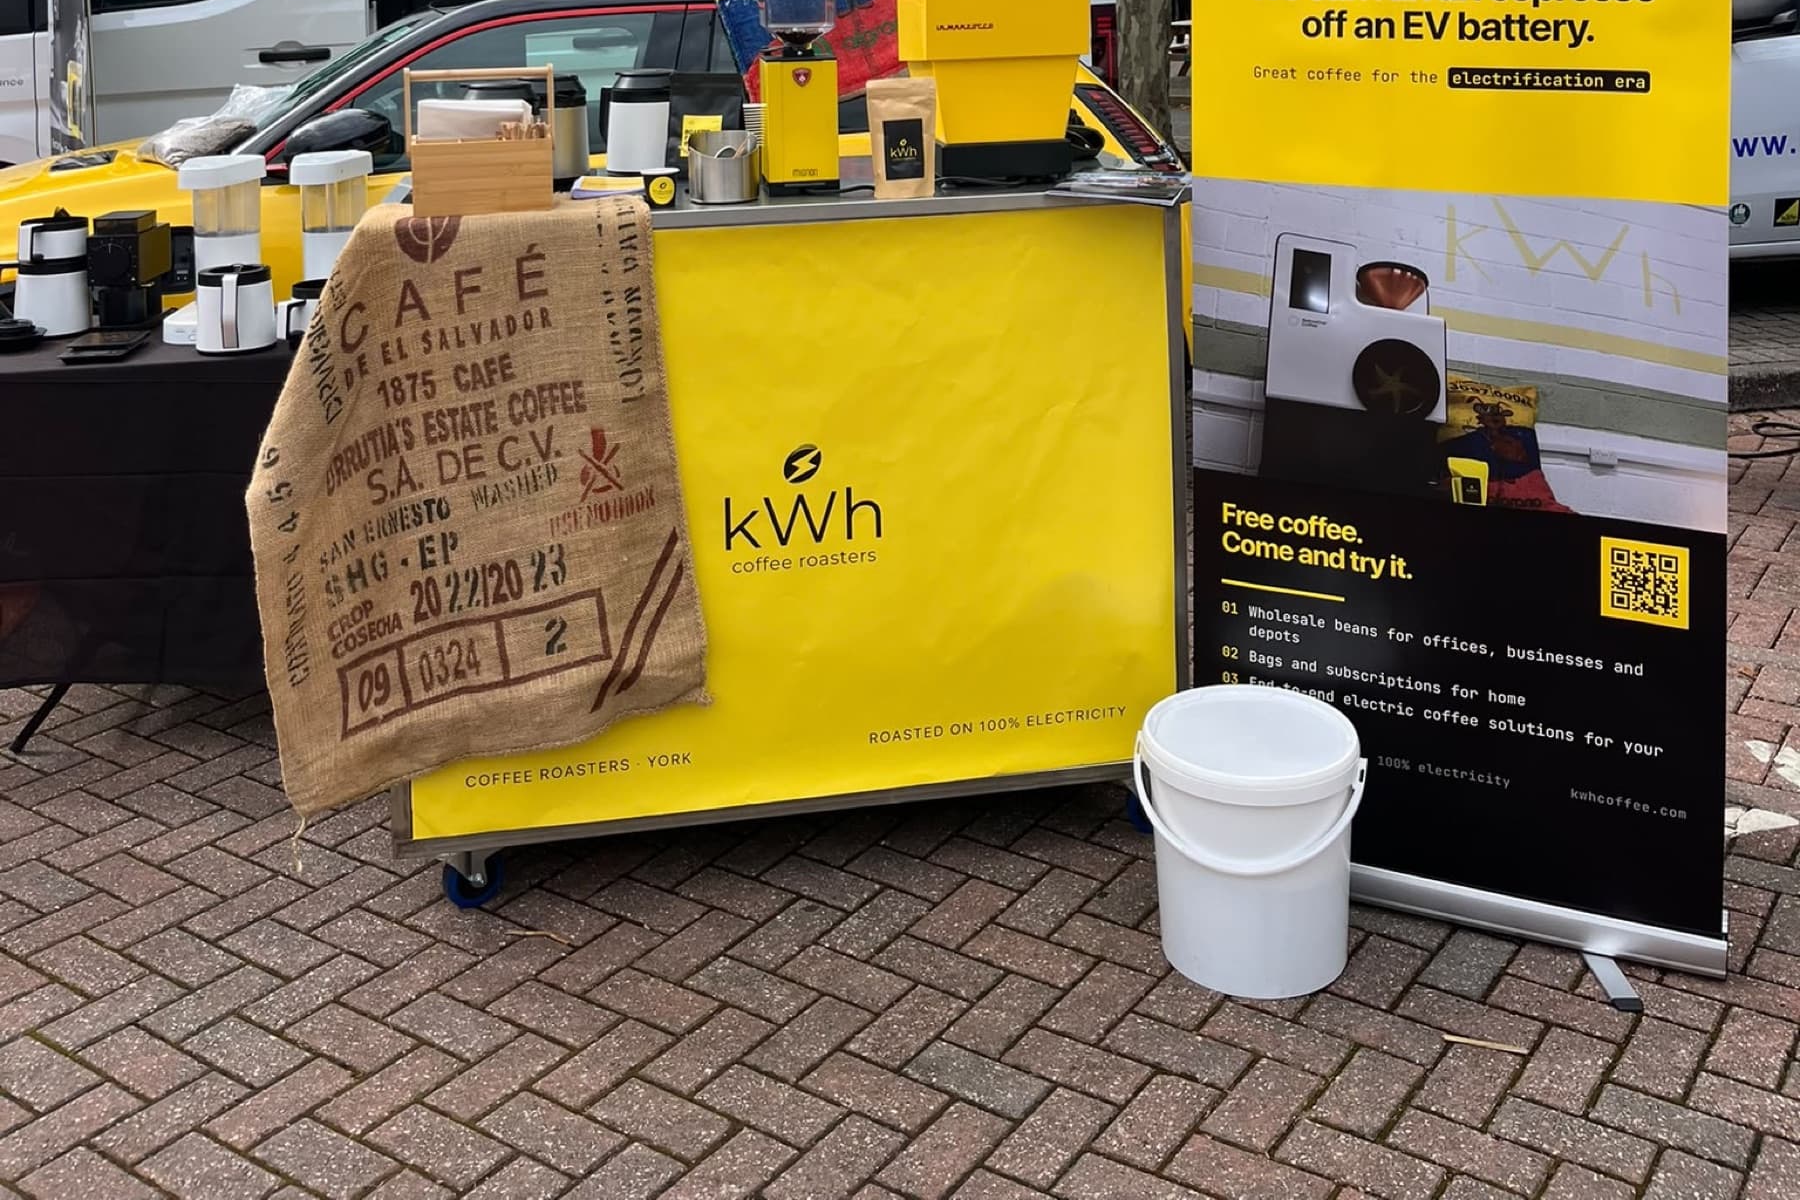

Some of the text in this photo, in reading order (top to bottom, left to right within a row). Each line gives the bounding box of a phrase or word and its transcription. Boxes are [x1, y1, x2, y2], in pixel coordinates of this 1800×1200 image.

[1302, 10, 1595, 48] off an EV battery.
[1253, 65, 1646, 89] Great coffee for the electrification era
[890, 145, 917, 158] kWh
[1444, 198, 1681, 315] kWh
[340, 243, 549, 354] CAFÉ
[345, 306, 552, 391] DE EL SALVADOR
[377, 353, 517, 409] 1875 CAFE
[423, 400, 499, 446] ESTATE
[508, 380, 588, 425] COFFEE
[366, 424, 562, 506] S.A. DE C.V.
[363, 497, 451, 544] ERNESTO
[724, 486, 882, 551] kWh
[1222, 502, 1364, 544] Free coffee.
[732, 550, 877, 574] coffee roasters
[1221, 531, 1413, 580] Come and try it.
[328, 600, 374, 643] CROP
[331, 612, 404, 660] COSECHA
[1222, 601, 1644, 677] 01 Wholesale beans for offices, businesses and
[1248, 625, 1301, 644] depots
[358, 616, 568, 712] 09 0324 2
[1222, 646, 1526, 706] 02 Bags and subscriptions for home
[869, 705, 1127, 744] ROASTED ON 100% ELECTRICITY
[1222, 671, 1239, 685] 03
[1343, 694, 1414, 717] electric
[1423, 707, 1479, 727] coffee
[1488, 718, 1575, 742] solutions
[1584, 731, 1614, 748] for
[1623, 741, 1664, 758] your
[465, 751, 692, 789] COFFEE ROASTERS YORK
[1377, 755, 1510, 789] 100% electricity
[1570, 788, 1687, 820] kwhcoffee.com
